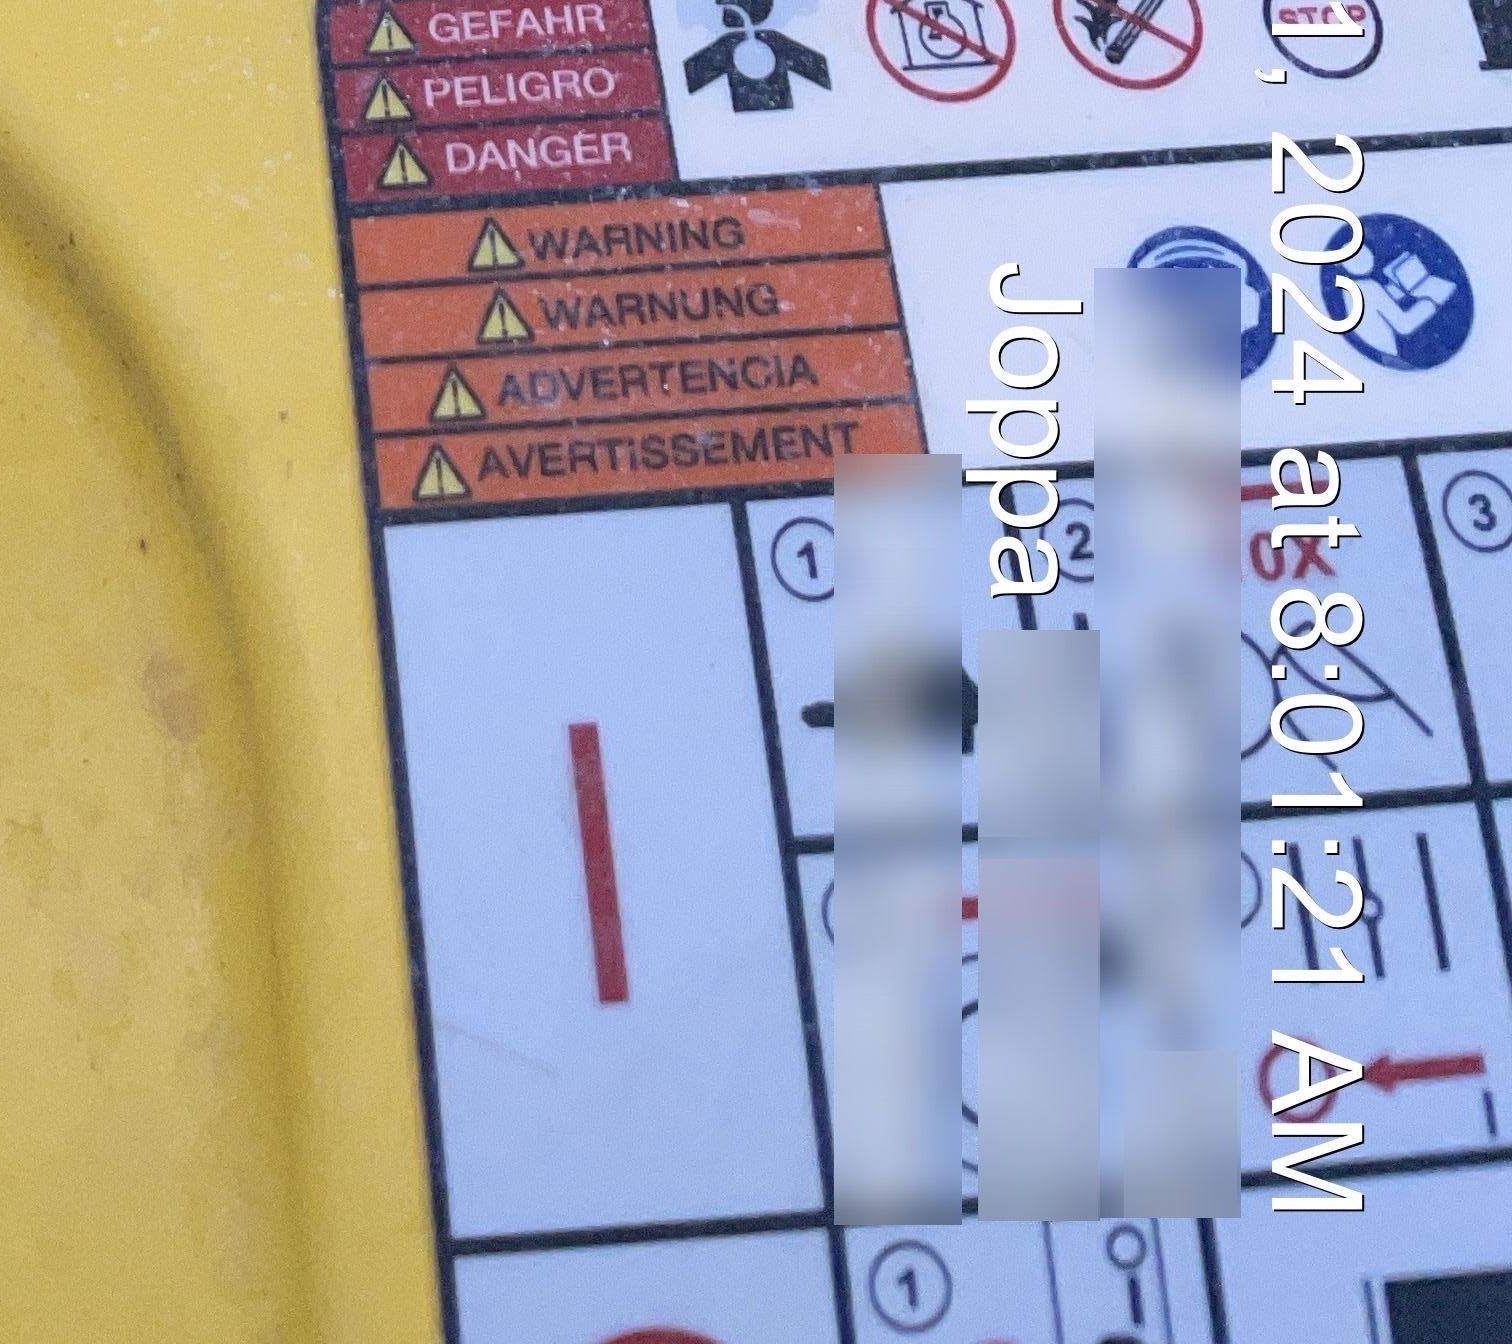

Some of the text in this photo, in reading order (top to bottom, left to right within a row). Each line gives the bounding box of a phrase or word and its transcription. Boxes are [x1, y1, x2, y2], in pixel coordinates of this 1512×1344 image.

[427, 3, 606, 43] GEFAHR
[424, 66, 616, 108] PELIGRO
[445, 132, 632, 175] DANGER
[529, 216, 745, 262] WARNING
[541, 283, 784, 330] WARNUNG
[497, 353, 819, 405] ADVERTENCIA
[477, 421, 859, 482] AVERTISSEMENT
